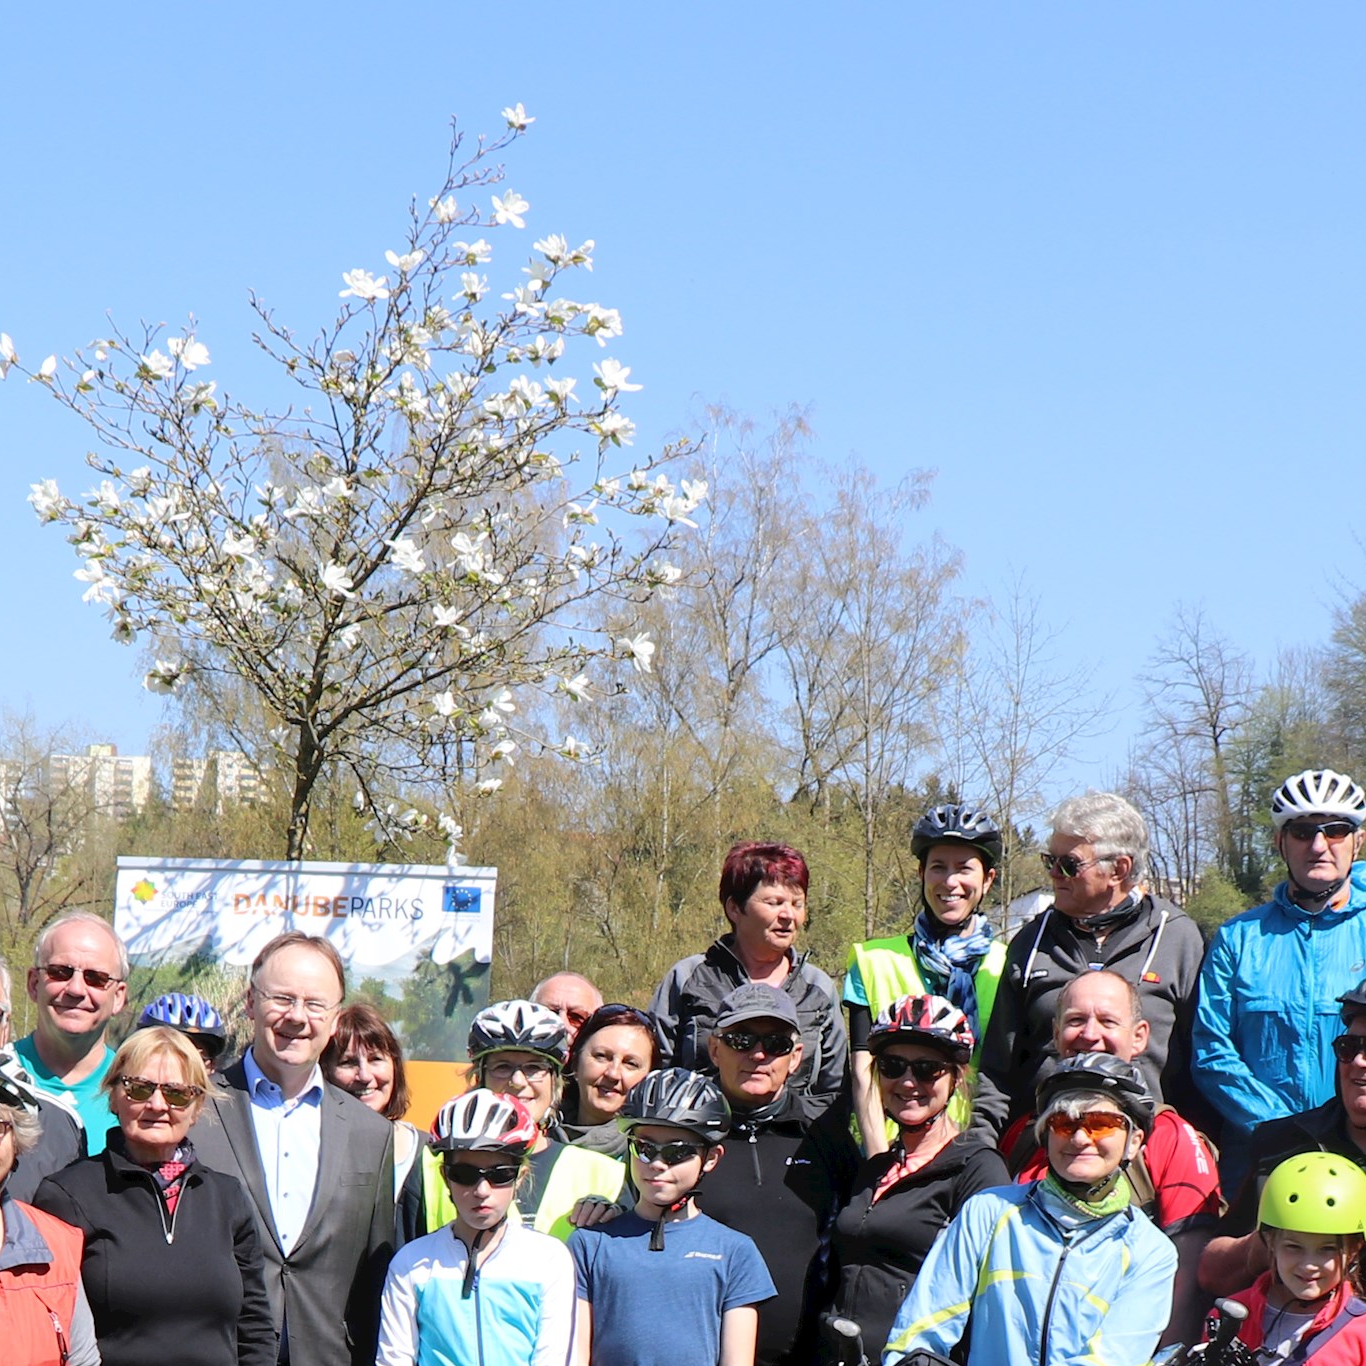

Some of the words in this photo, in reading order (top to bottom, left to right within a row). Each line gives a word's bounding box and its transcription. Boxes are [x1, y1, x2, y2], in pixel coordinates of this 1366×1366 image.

[161, 892, 194, 900] SOUTH
[196, 892, 218, 900] EAST
[161, 900, 197, 908] EUROPE
[235, 893, 424, 920] DANUBEPARKS
